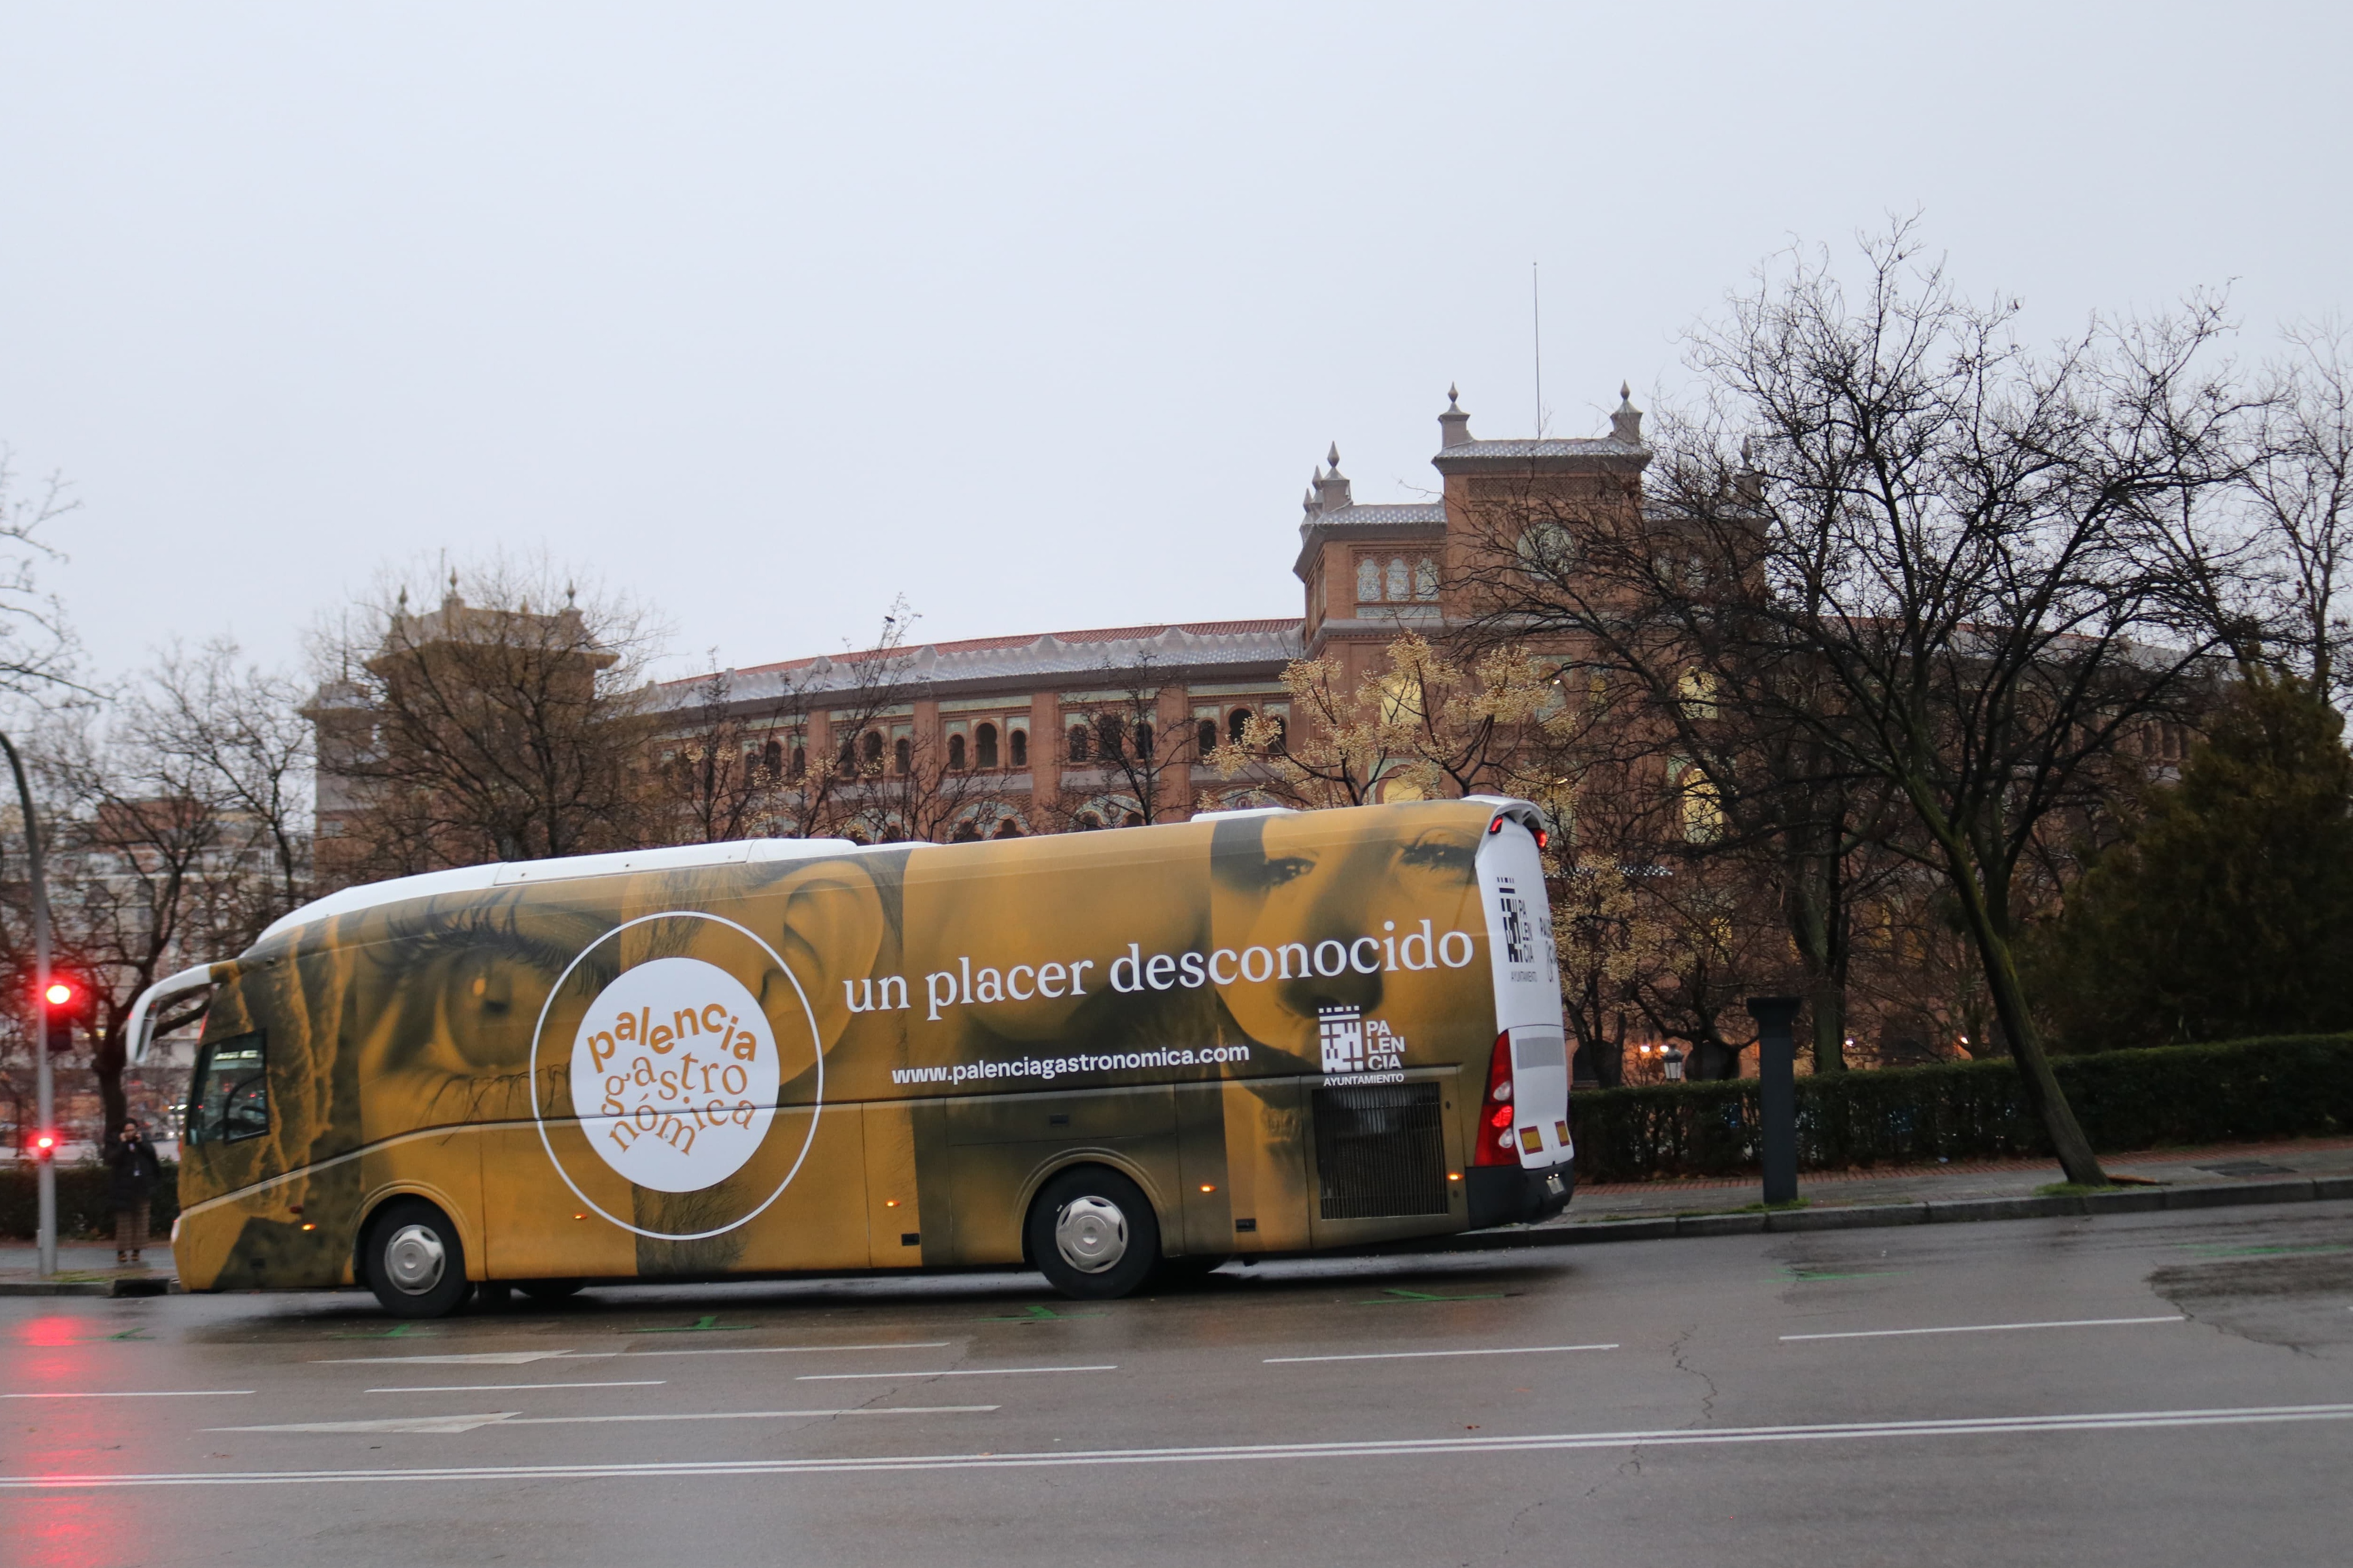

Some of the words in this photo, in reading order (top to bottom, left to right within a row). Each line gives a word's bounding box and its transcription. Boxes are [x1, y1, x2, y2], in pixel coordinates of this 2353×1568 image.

[843, 974, 912, 1013] un
[924, 957, 1095, 1021] placer
[1110, 920, 1474, 993] desconocido
[588, 1003, 757, 1074] palencia
[1366, 1020, 1391, 1037] PA
[1367, 1036, 1406, 1054] LEN
[892, 1046, 1250, 1084] www.palenciagastronomica.com
[1323, 1074, 1405, 1086] AYUNTAMIENTO
[1368, 1054, 1403, 1071] CIA
[601, 1052, 748, 1116] gastro
[609, 1093, 756, 1156] nómica
